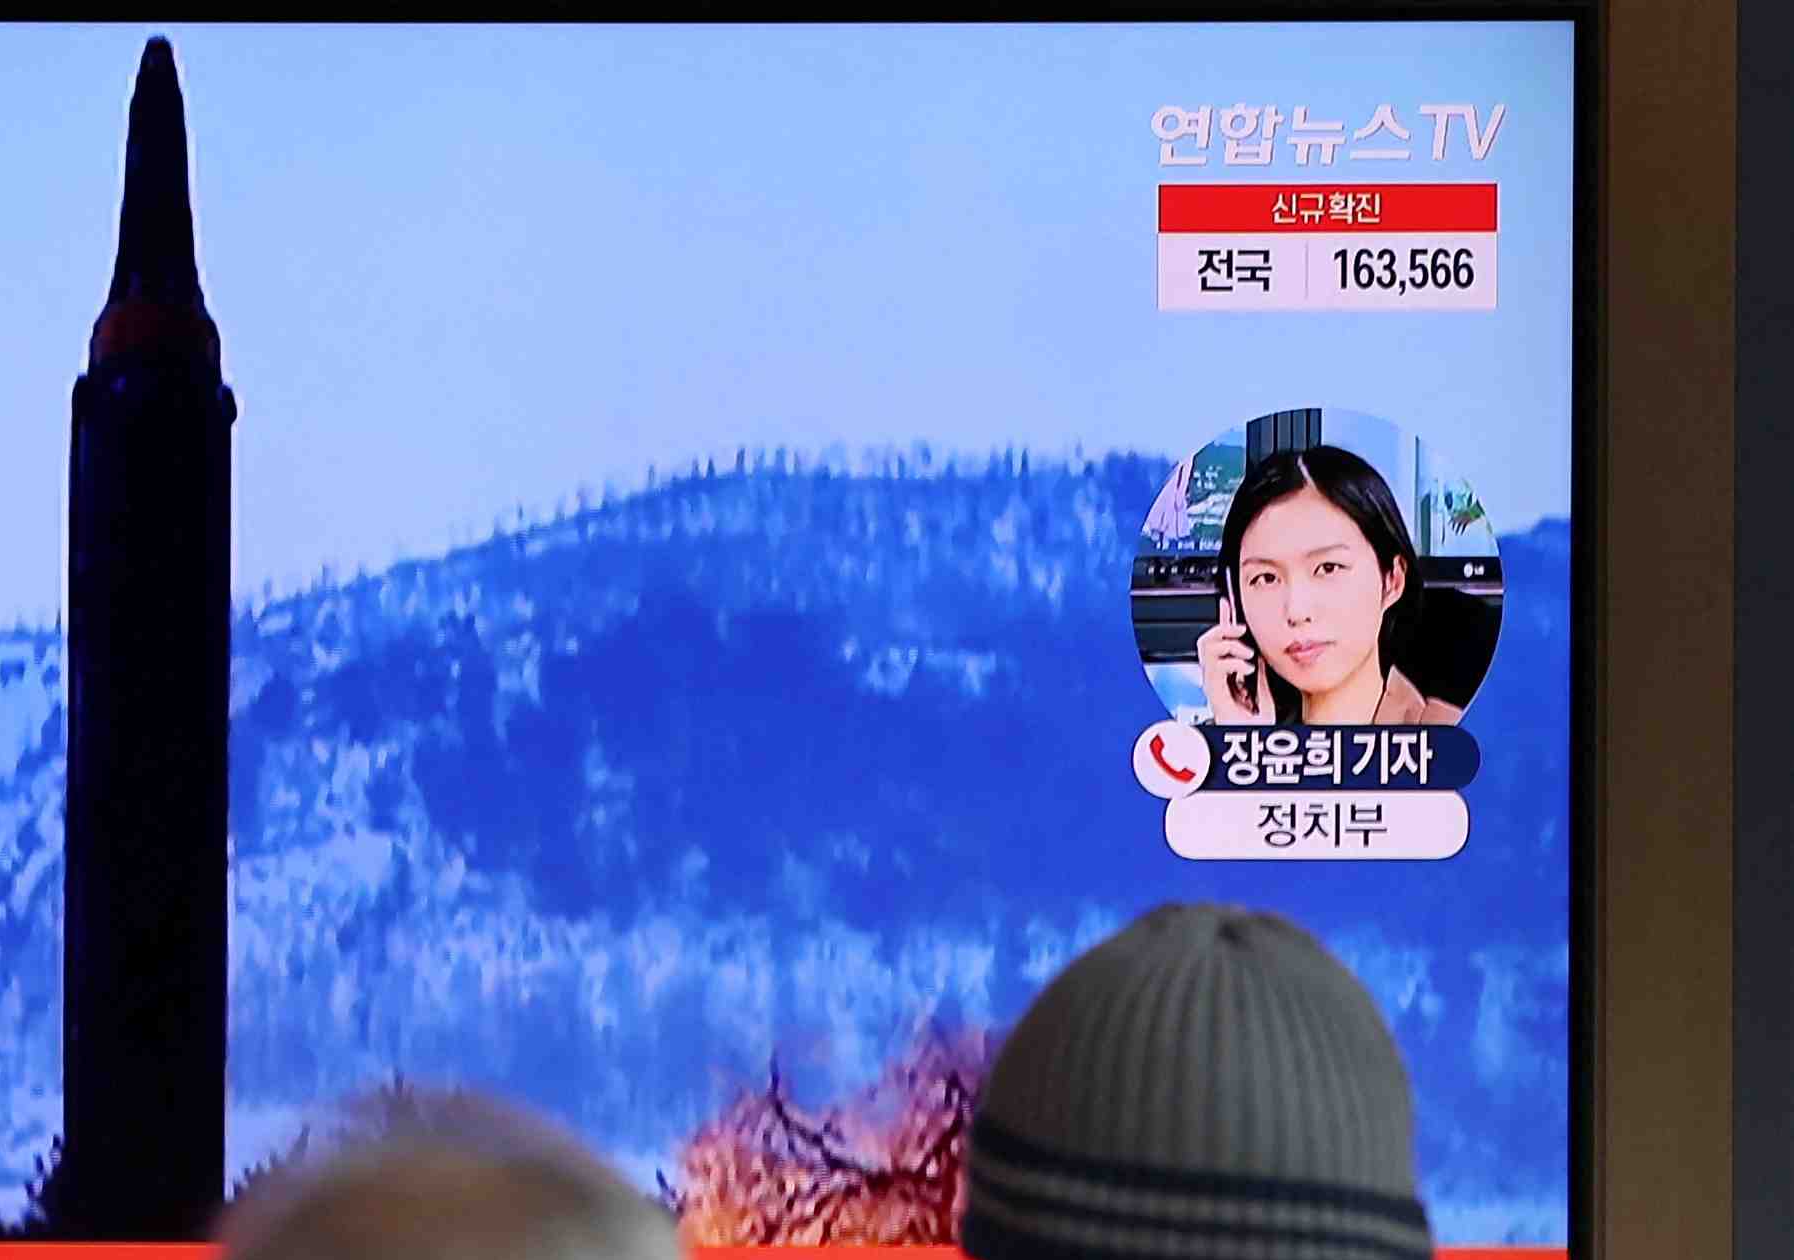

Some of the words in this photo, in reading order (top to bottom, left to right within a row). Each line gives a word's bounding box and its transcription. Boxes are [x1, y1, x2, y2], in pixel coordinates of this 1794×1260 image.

[1197, 249, 1273, 292] 전국
[1333, 248, 1475, 296] 163,566
[1221, 730, 1342, 785] 장윤희
[1352, 730, 1433, 785] 기자
[1258, 803, 1387, 847] 정치부
